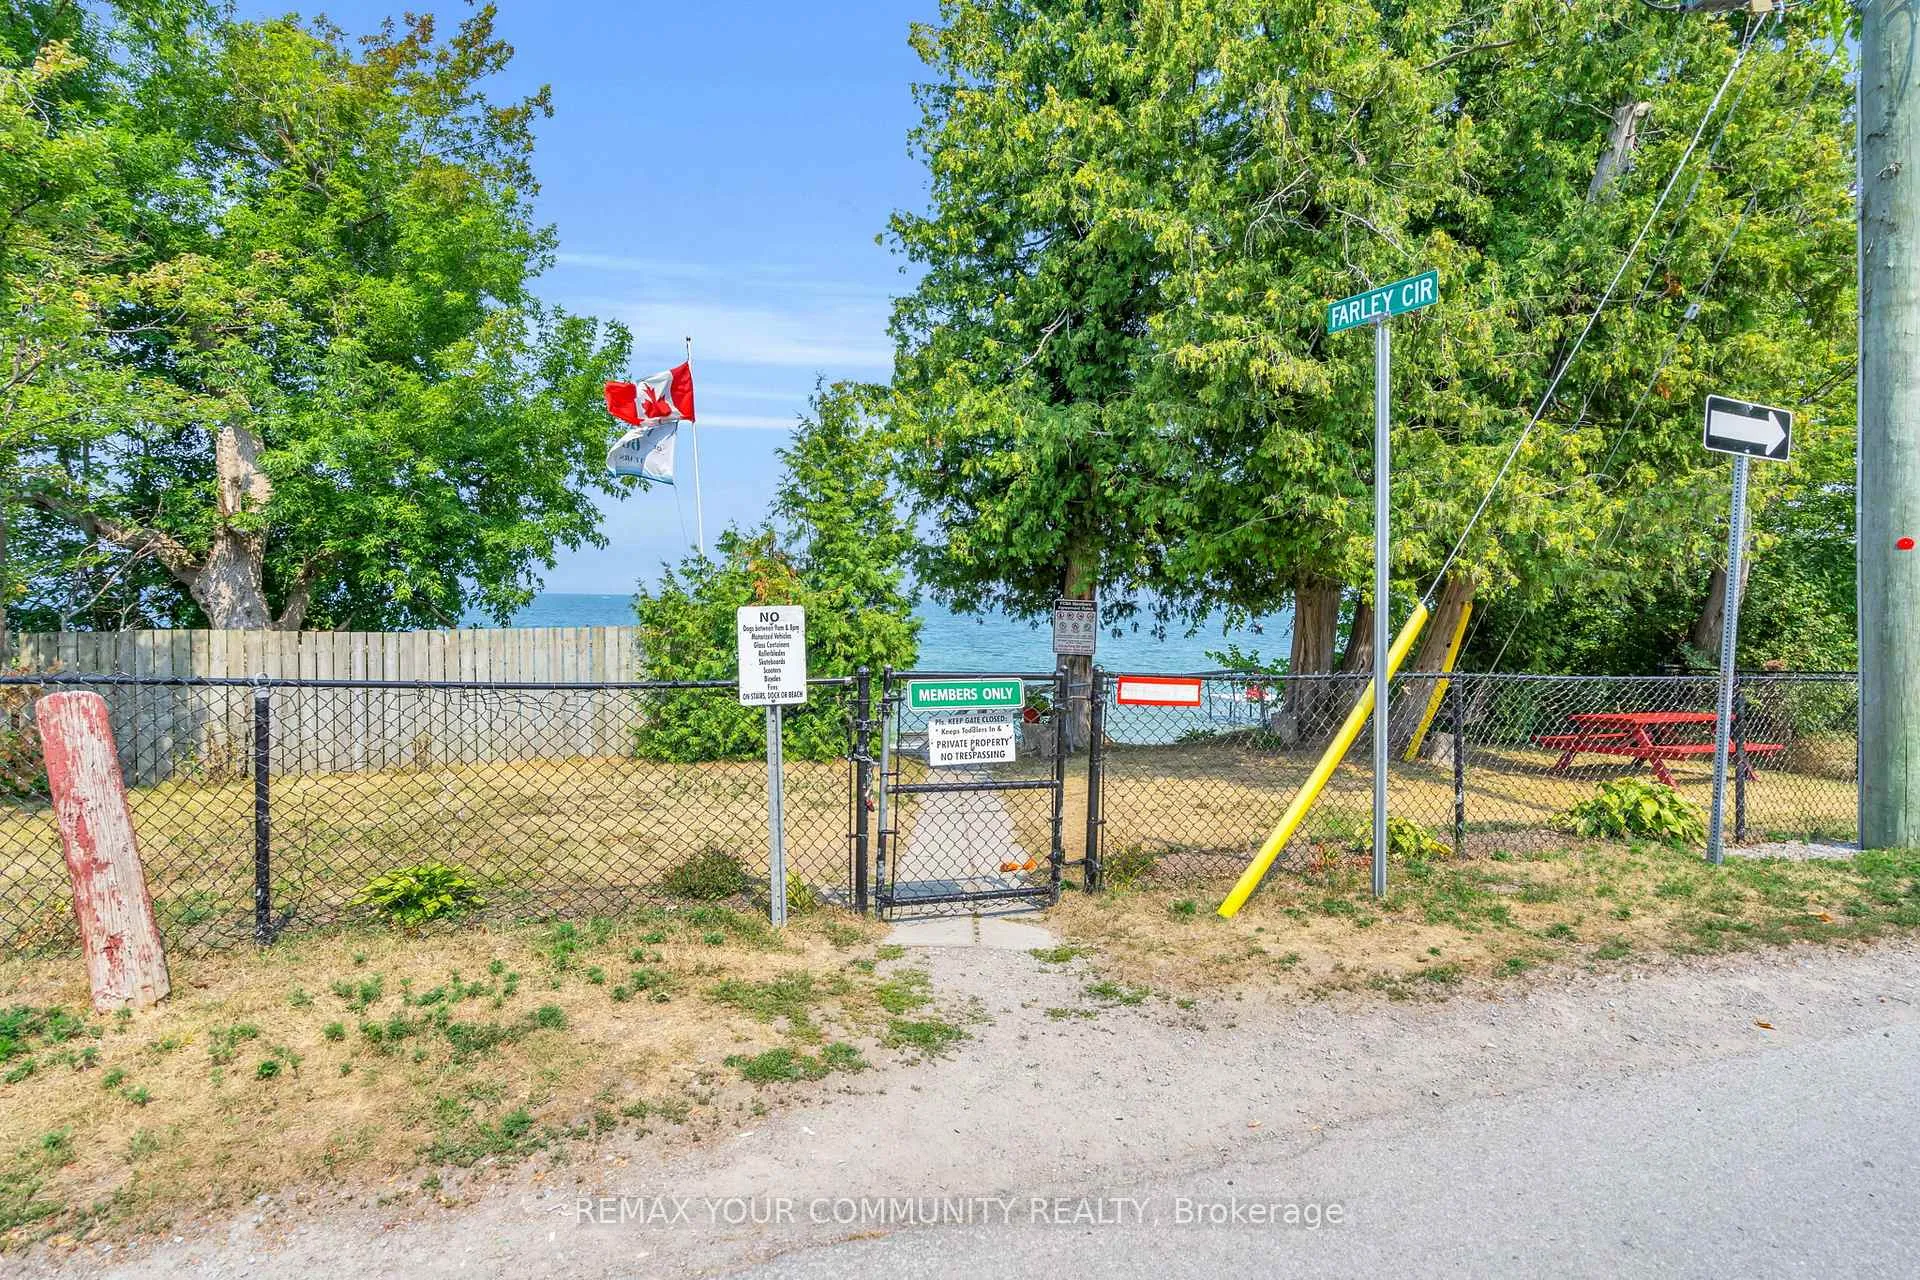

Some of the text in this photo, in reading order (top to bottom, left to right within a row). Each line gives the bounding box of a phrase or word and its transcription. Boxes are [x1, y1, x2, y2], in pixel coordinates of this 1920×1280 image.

[1331, 278, 1433, 328] FARLEY CIR
[759, 612, 780, 622] NO
[743, 624, 754, 633] Dogs
[755, 624, 773, 632] between
[758, 649, 786, 657] Rollerblades
[789, 690, 803, 698] BEACH
[919, 687, 1013, 701] MEMBERS ONLY
[948, 717, 962, 725] KEEP
[961, 726, 987, 734] Toddlers
[936, 737, 1009, 749] PRIVATE PROPERTY
[940, 750, 1006, 760] NO TRESPASSING
